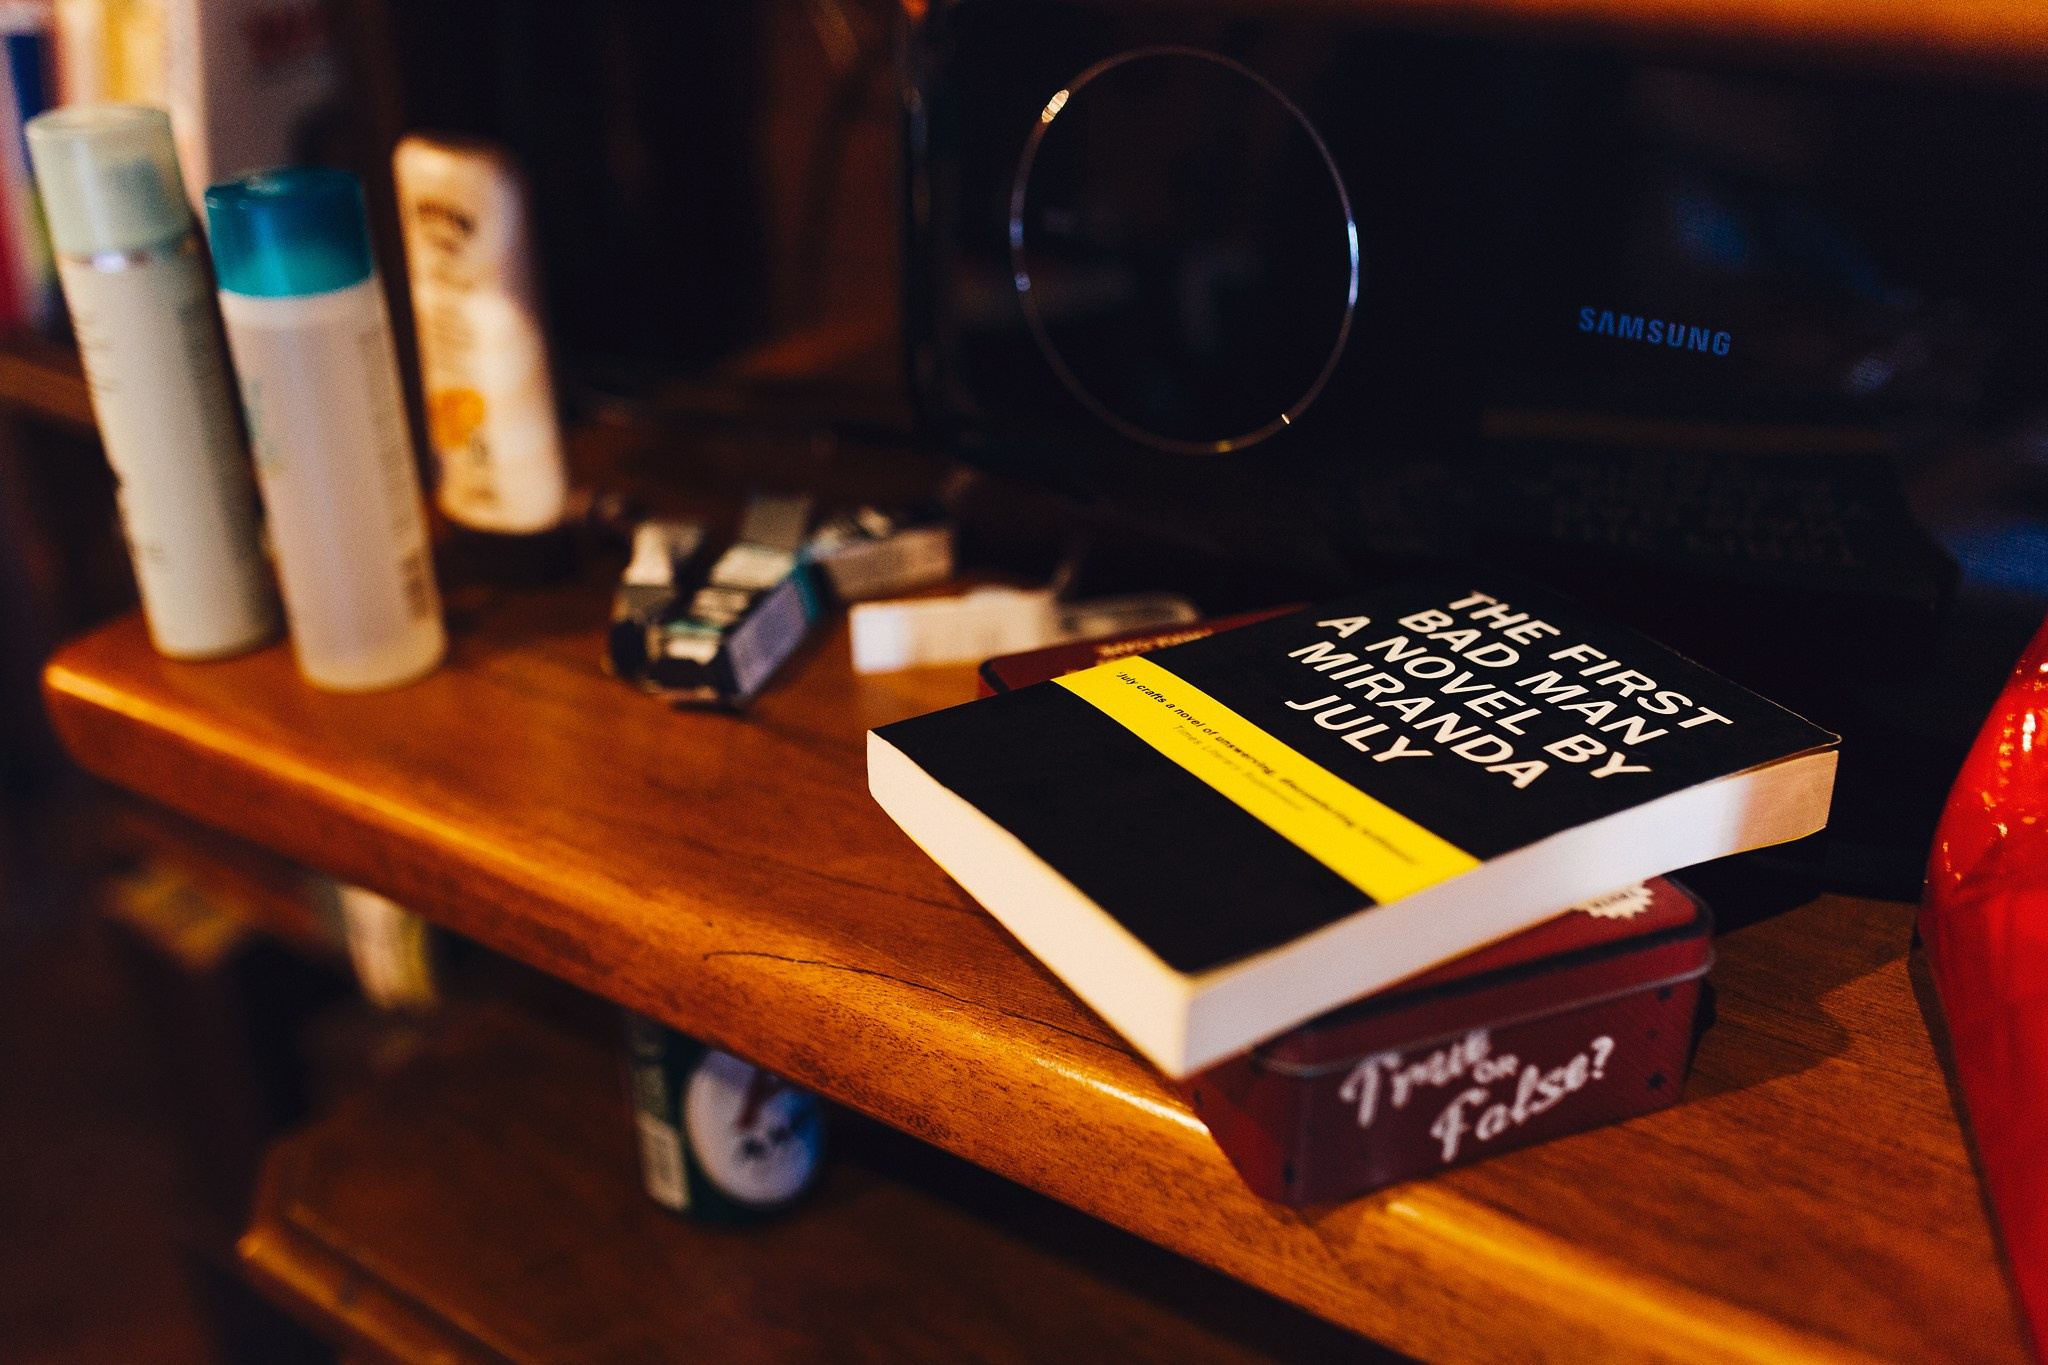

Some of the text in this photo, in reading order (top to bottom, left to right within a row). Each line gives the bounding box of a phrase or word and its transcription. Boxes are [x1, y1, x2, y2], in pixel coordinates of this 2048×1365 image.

[1578, 306, 1732, 356] SAMSUNG
[1136, 684, 1167, 704] crafts
[1174, 708, 1206, 728] novel
[1202, 727, 1219, 736] of
[1287, 640, 1550, 790] MIRANDA
[1316, 615, 1653, 779] A NOVEL BY
[1398, 608, 1669, 746] BAD MAN
[1449, 591, 1735, 729] THE FIRST
[1284, 694, 1435, 763] JULY
[1339, 1029, 1491, 1129] True
[1430, 1036, 1614, 1163] False?
